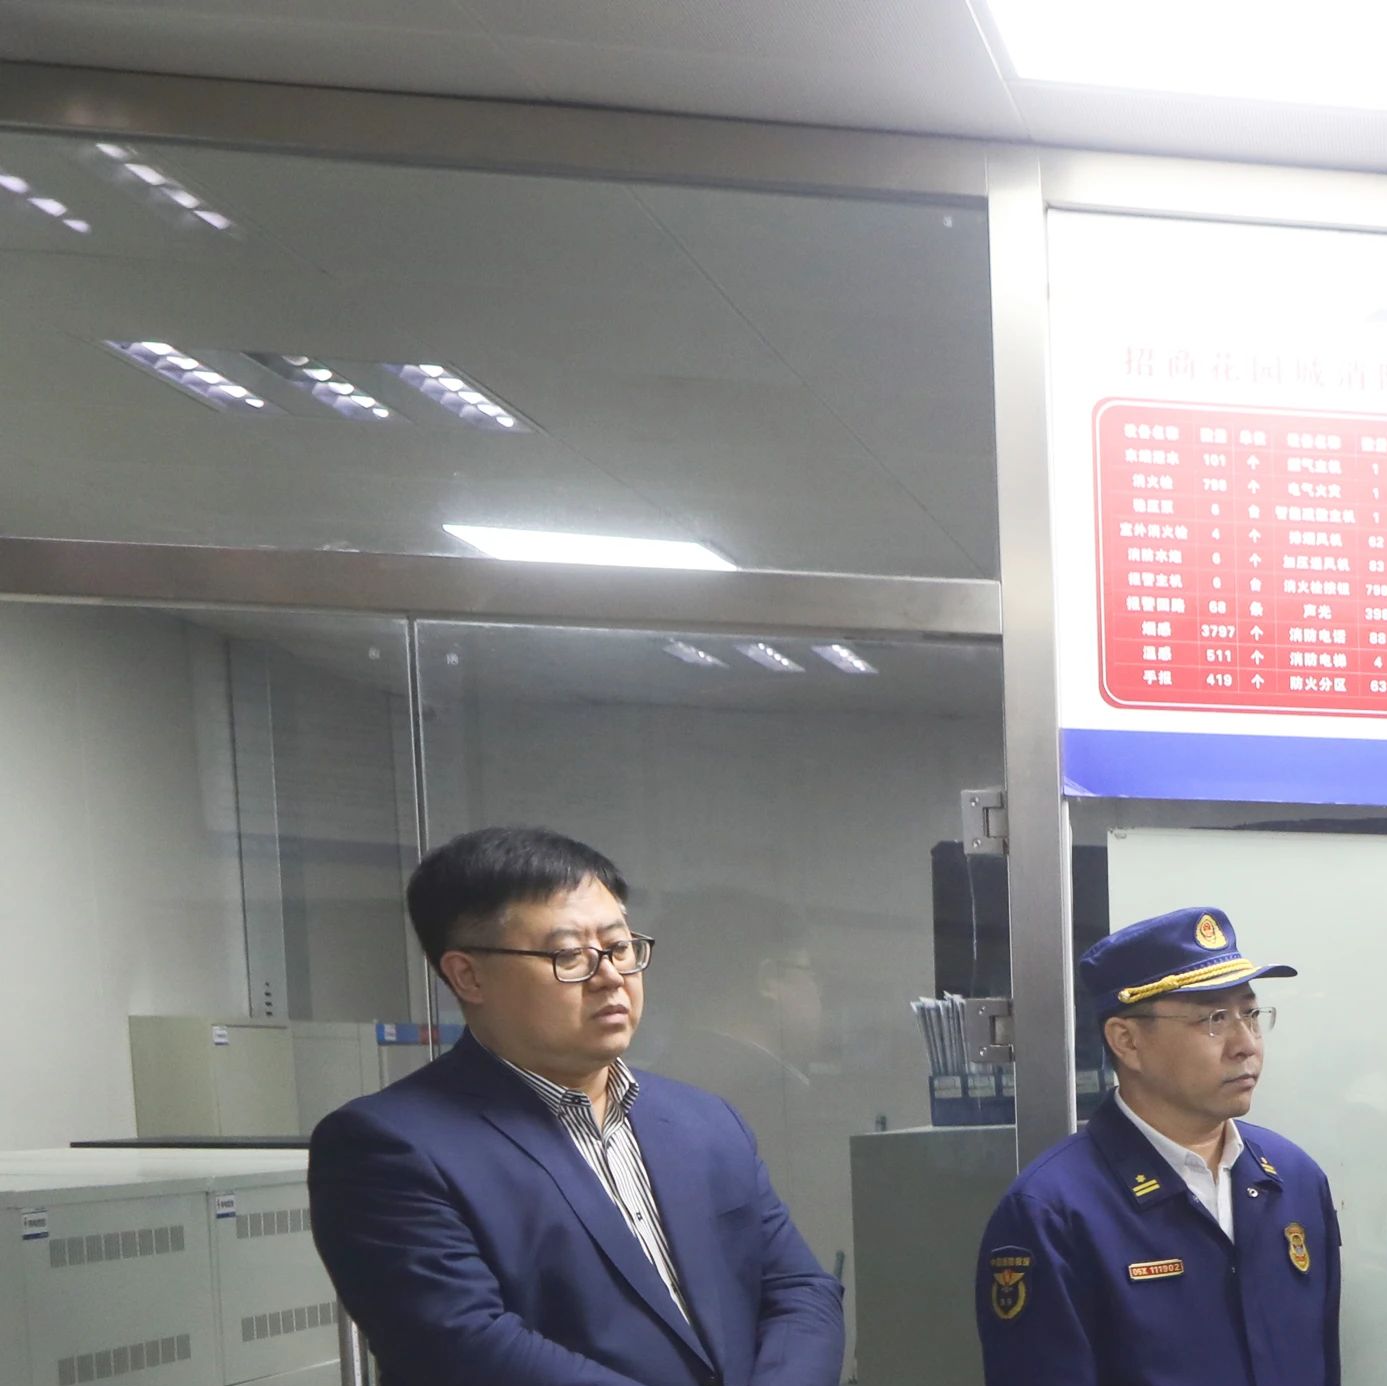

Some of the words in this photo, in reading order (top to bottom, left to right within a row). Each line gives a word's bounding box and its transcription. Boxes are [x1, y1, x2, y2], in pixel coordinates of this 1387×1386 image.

[1247, 455, 1260, 470] 个
[1372, 463, 1379, 475] 1
[1132, 473, 1173, 490] 消火栓
[1247, 479, 1260, 494] 个
[1287, 482, 1341, 498] 电气火灾
[1372, 487, 1379, 499] 1
[1248, 504, 1260, 519] 台
[1373, 512, 1379, 523] 1
[1119, 522, 1188, 540] 室外消火栓
[1211, 527, 1220, 540] 4
[1248, 529, 1261, 543] 个
[1289, 530, 1343, 547] 排烟风机
[1127, 547, 1182, 564] 消防水炮
[1249, 553, 1262, 567] 个
[1128, 572, 1183, 588] 报警主机
[1250, 577, 1262, 591] 台
[1284, 579, 1350, 595] 消火栓按钮
[1126, 596, 1185, 613] 报警回路
[1208, 600, 1226, 614] 68
[1249, 601, 1263, 617] 条
[1303, 603, 1332, 620] 声光
[1141, 621, 1172, 637] 烟感
[1201, 624, 1235, 638] 3797
[1250, 625, 1264, 641] 个
[1289, 627, 1346, 644] 消防电话
[1142, 645, 1172, 661] 温感
[1206, 649, 1231, 662] 511
[1250, 650, 1264, 665] 个
[1289, 651, 1347, 668] 消防电梯
[1373, 656, 1383, 668] 4
[1143, 670, 1172, 685] 手报
[1206, 673, 1233, 686] 419
[1251, 674, 1265, 689] 个
[1289, 675, 1347, 692] 防火分区
[1370, 680, 1387, 693] 63
